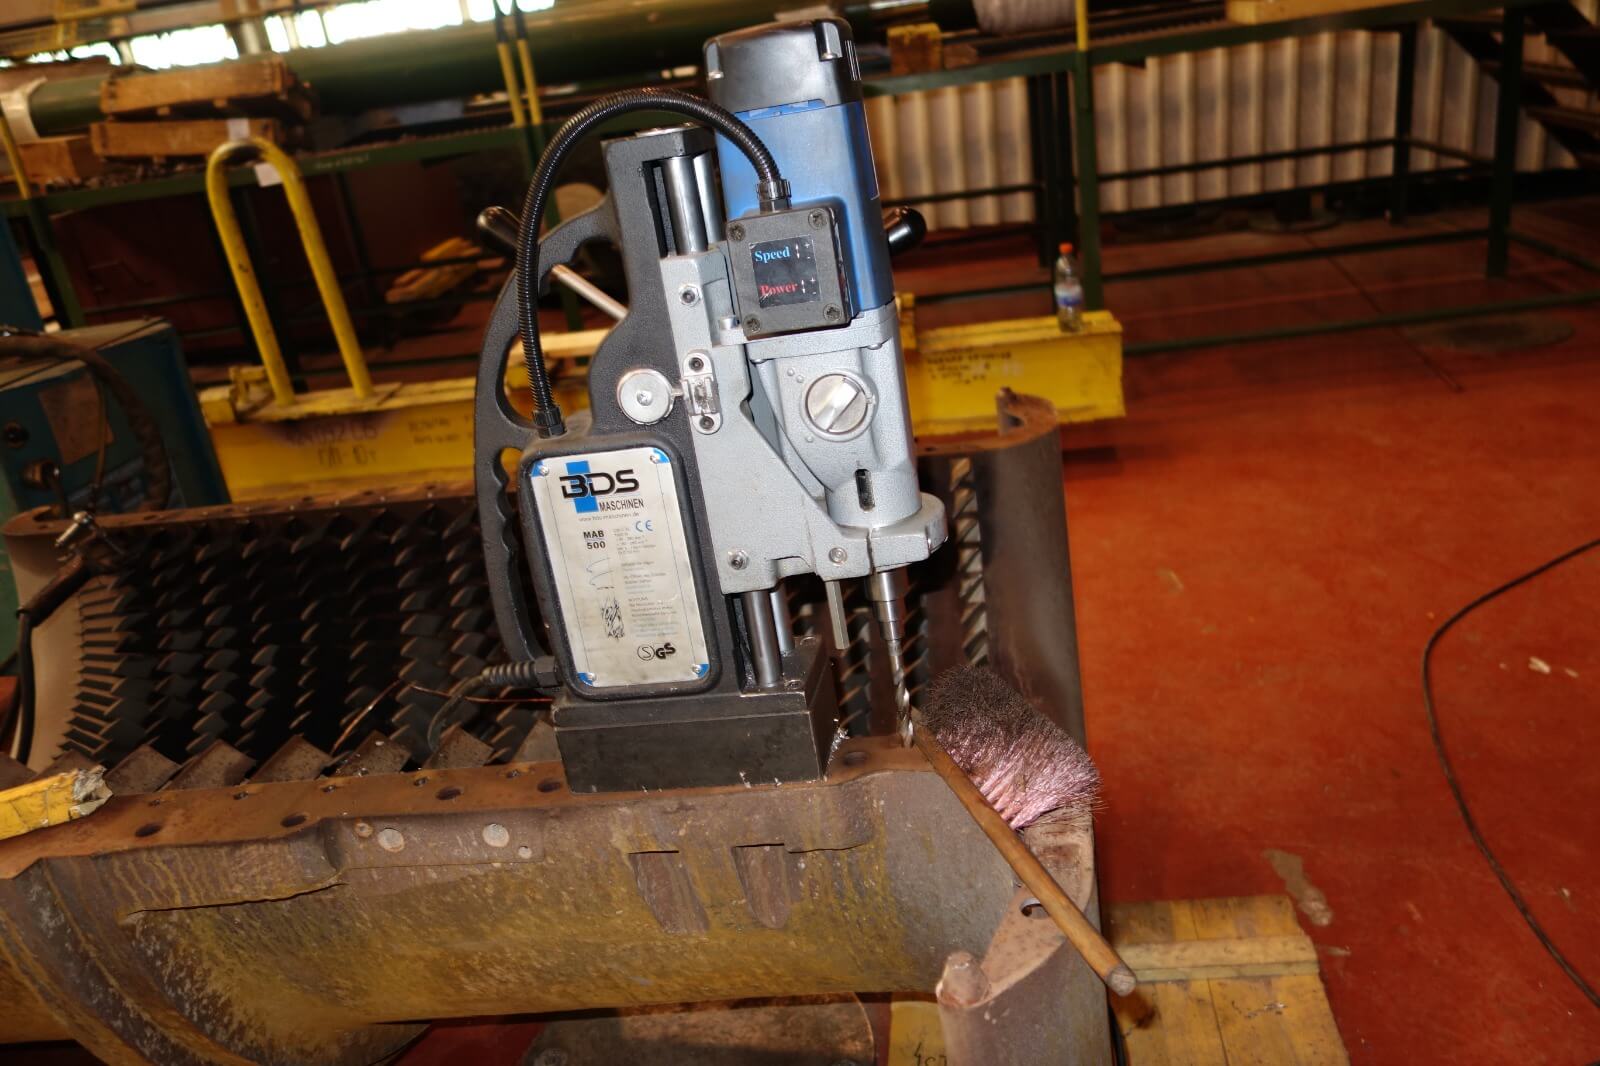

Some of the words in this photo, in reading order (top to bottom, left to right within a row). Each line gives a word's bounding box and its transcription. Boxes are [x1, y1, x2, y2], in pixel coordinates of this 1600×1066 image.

[754, 246, 791, 264] Speed
[760, 283, 798, 297] Power
[559, 469, 640, 499] BDS
[599, 498, 645, 512] MASCHINEN
[583, 530, 605, 539] MAB
[586, 541, 606, 550] 500
